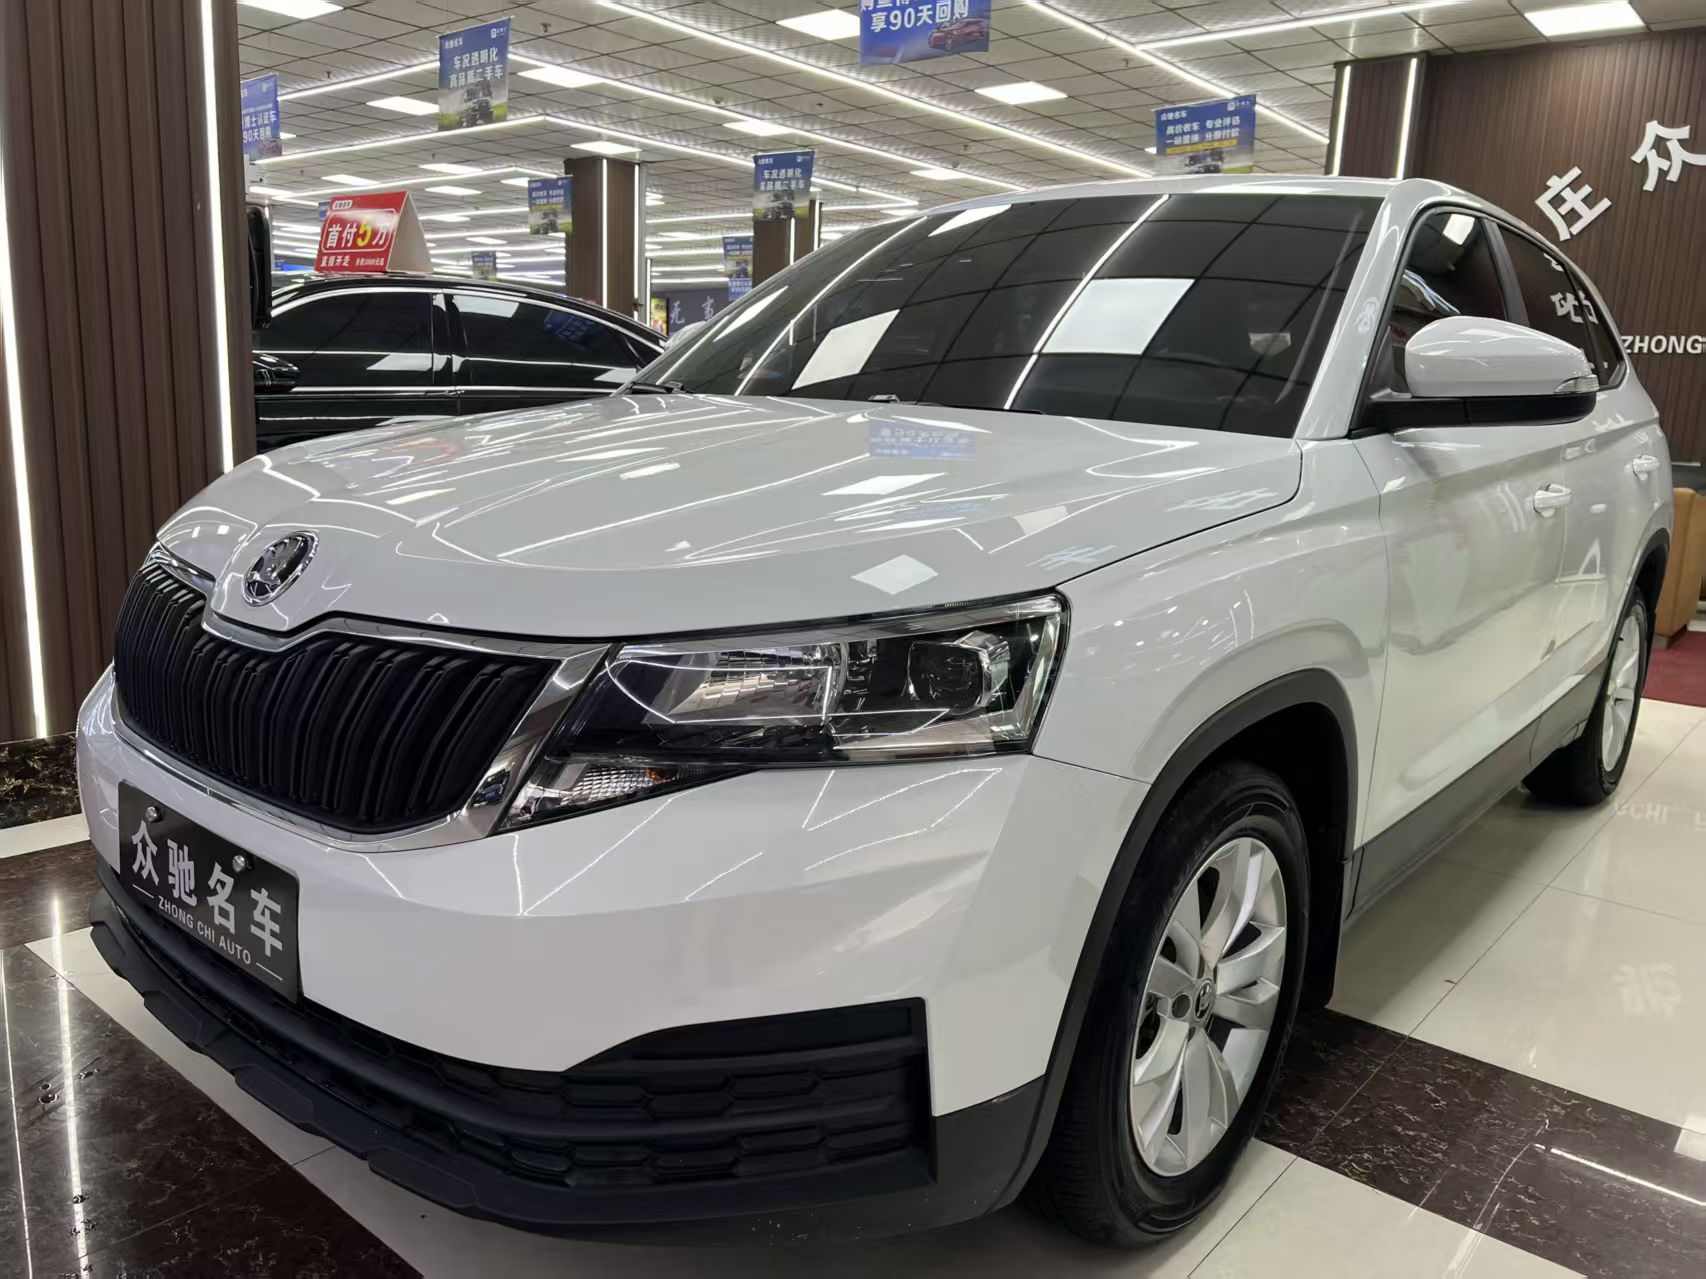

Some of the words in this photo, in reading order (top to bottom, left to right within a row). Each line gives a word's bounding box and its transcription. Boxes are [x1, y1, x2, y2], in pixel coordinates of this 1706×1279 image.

[870, 0, 969, 33] 享90天回购
[453, 46, 499, 70] 车况透明化
[449, 64, 504, 89] 高品质二手车
[327, 222, 391, 249] 首付5万
[131, 819, 284, 958] 众驰名车
[157, 895, 194, 929] ZHONG
[197, 919, 215, 943] CHI
[219, 935, 251, 965] AUTO
